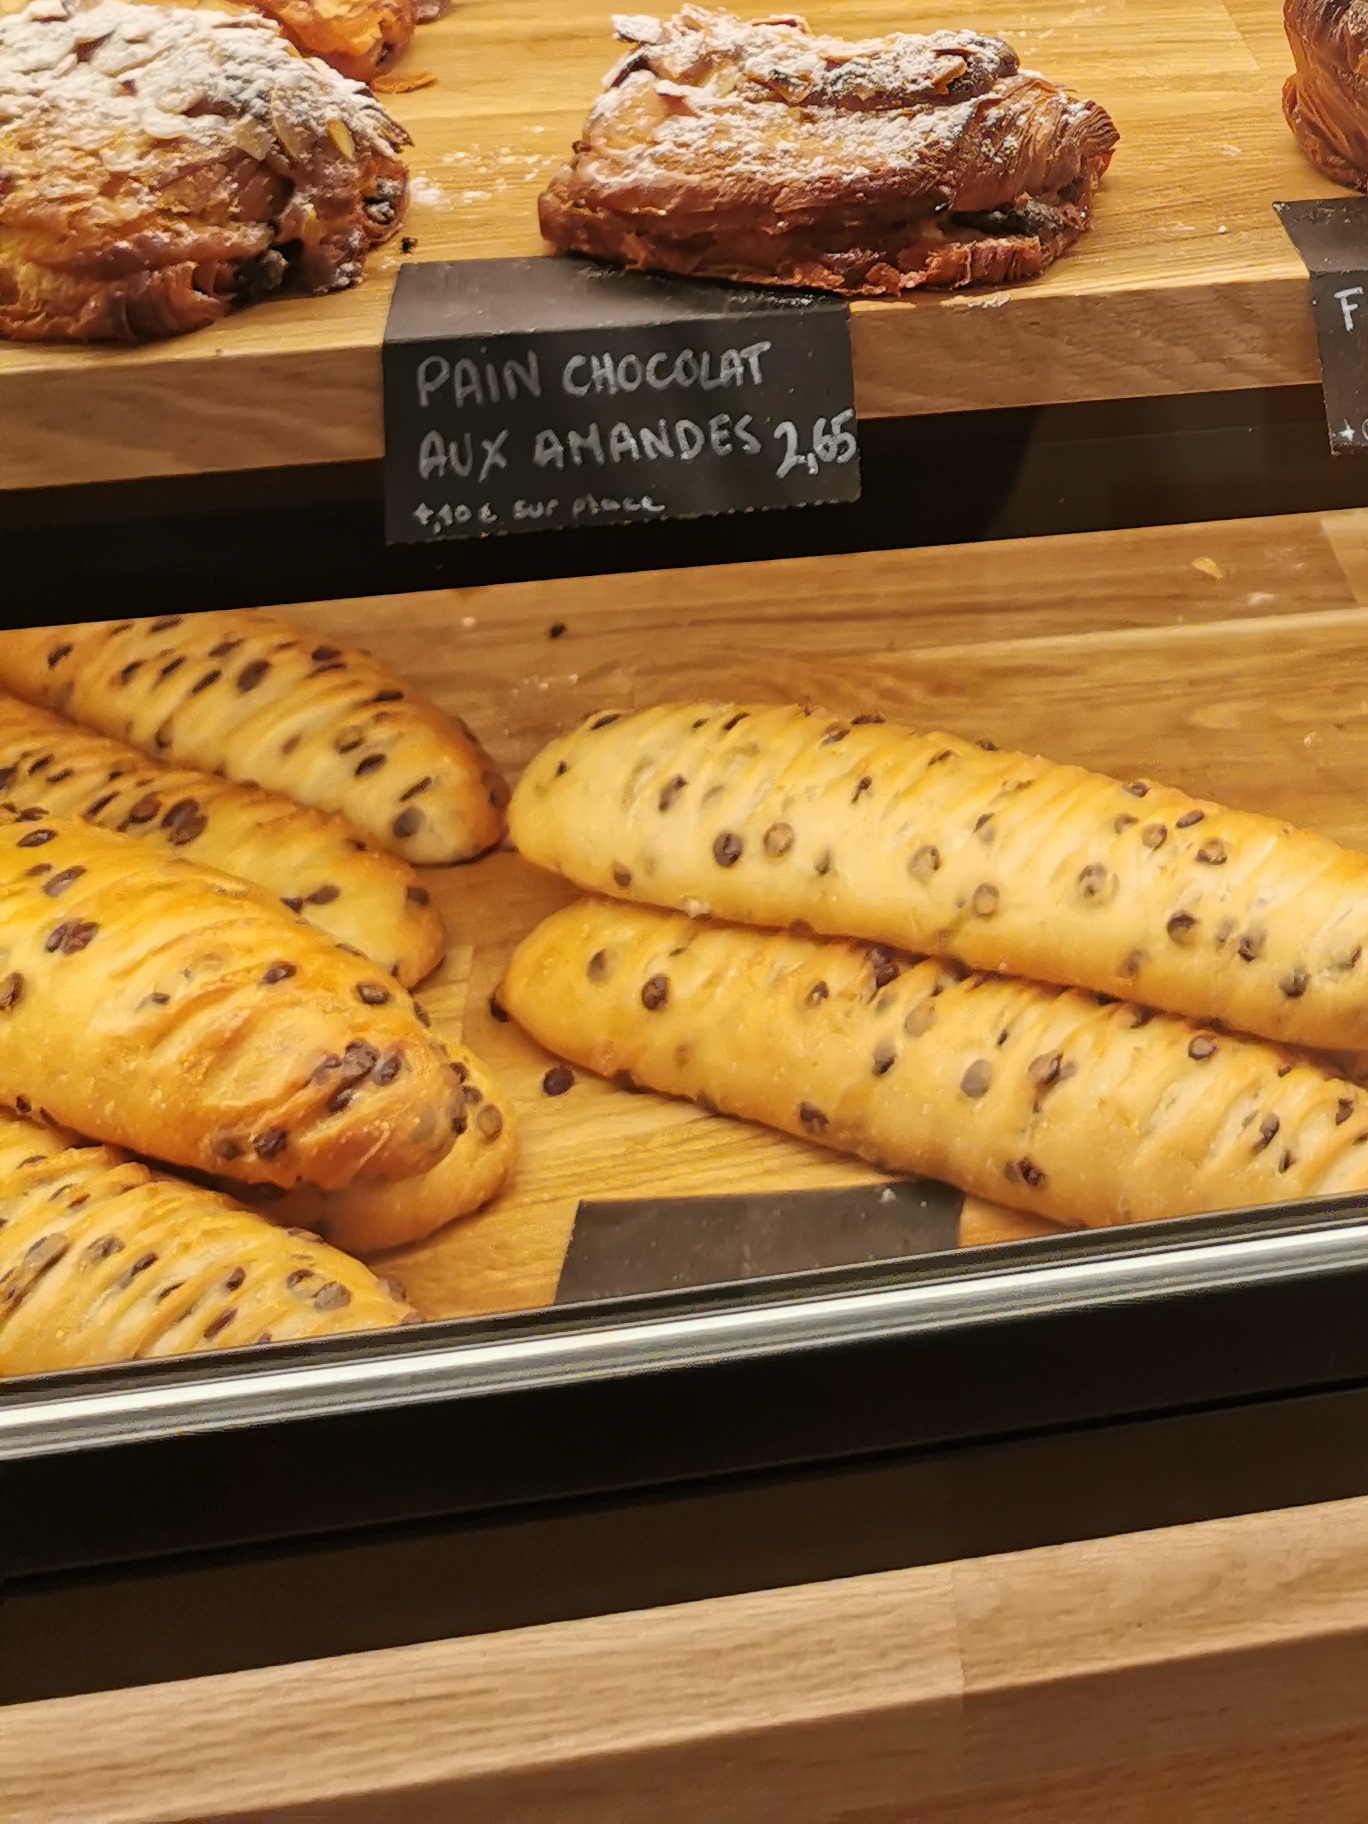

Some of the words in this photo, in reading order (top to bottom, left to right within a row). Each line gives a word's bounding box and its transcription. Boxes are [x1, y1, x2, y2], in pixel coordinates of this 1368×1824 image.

[416, 349, 541, 408] PAIN
[562, 341, 772, 397] CHOCOLAT
[417, 428, 511, 482] AUX
[533, 413, 761, 470] AMANDES
[773, 408, 857, 479] 2,65
[513, 498, 559, 520] sur
[571, 492, 666, 521] place
